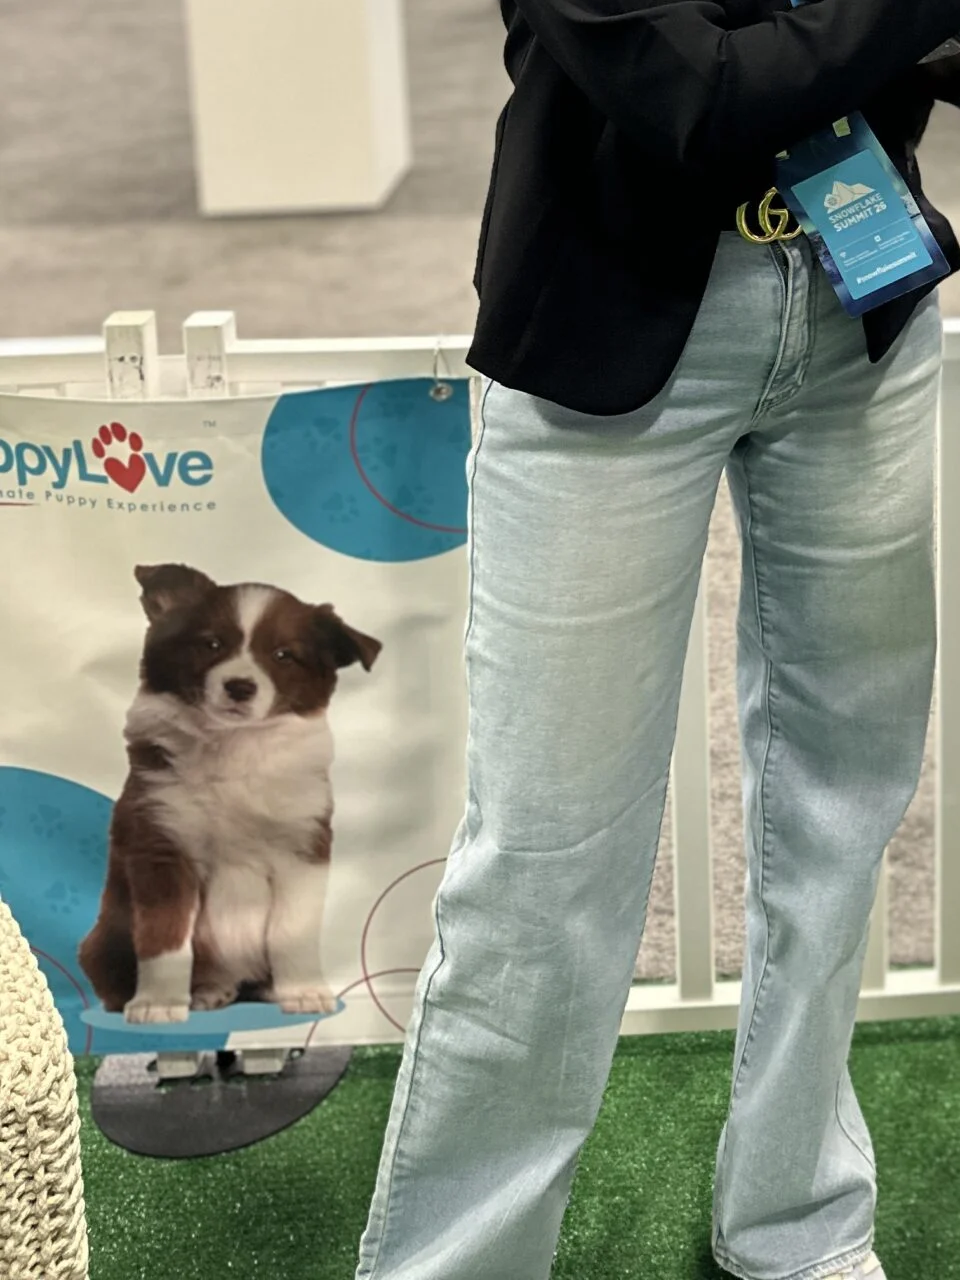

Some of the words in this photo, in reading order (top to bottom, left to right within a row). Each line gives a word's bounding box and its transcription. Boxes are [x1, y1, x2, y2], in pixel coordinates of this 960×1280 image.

[828, 192, 883, 224] SNOWFLAKE
[833, 207, 873, 232] SUMMIT
[45, 490, 97, 509] Puppy
[107, 498, 217, 513] Experience
